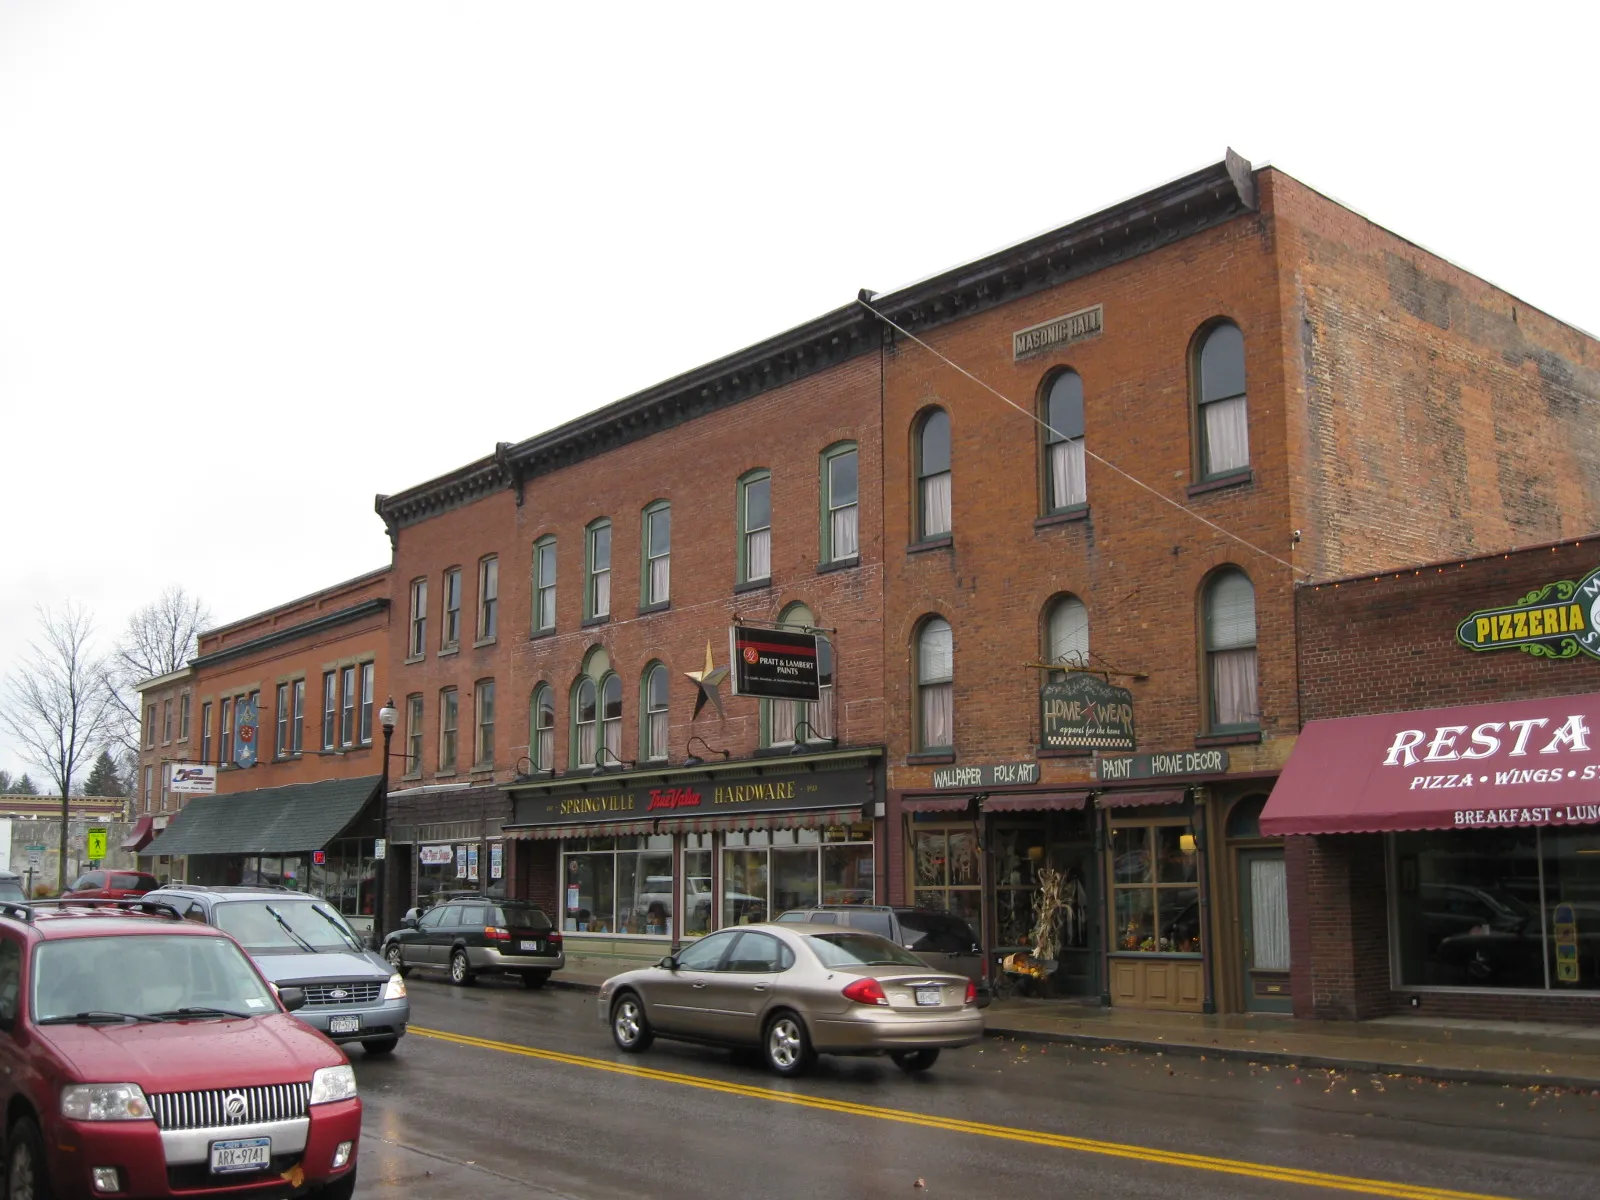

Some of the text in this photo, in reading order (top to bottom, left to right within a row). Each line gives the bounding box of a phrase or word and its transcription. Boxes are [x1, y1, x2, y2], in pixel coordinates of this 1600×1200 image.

[1016, 311, 1100, 352] MASONIC HALL
[1476, 604, 1585, 643] PIZZERIA
[760, 657, 814, 669] PRATT & LAMBERT
[777, 667, 798, 675] PAINTS
[1044, 699, 1133, 735] HOME WEAR
[1059, 725, 1120, 737] apparel for the home
[933, 763, 1035, 788] WALLPAPER FOLK ART
[1102, 751, 1222, 779] PAINT HOME DECOR
[1409, 773, 1474, 790] PIZZA
[1494, 768, 1564, 786] WINGS
[560, 793, 635, 815] SPRINGVILLE
[714, 781, 796, 804] HARDWARE
[1454, 804, 1600, 825] BREAKFAST LUN
[217, 1147, 264, 1166] ARX-9741
